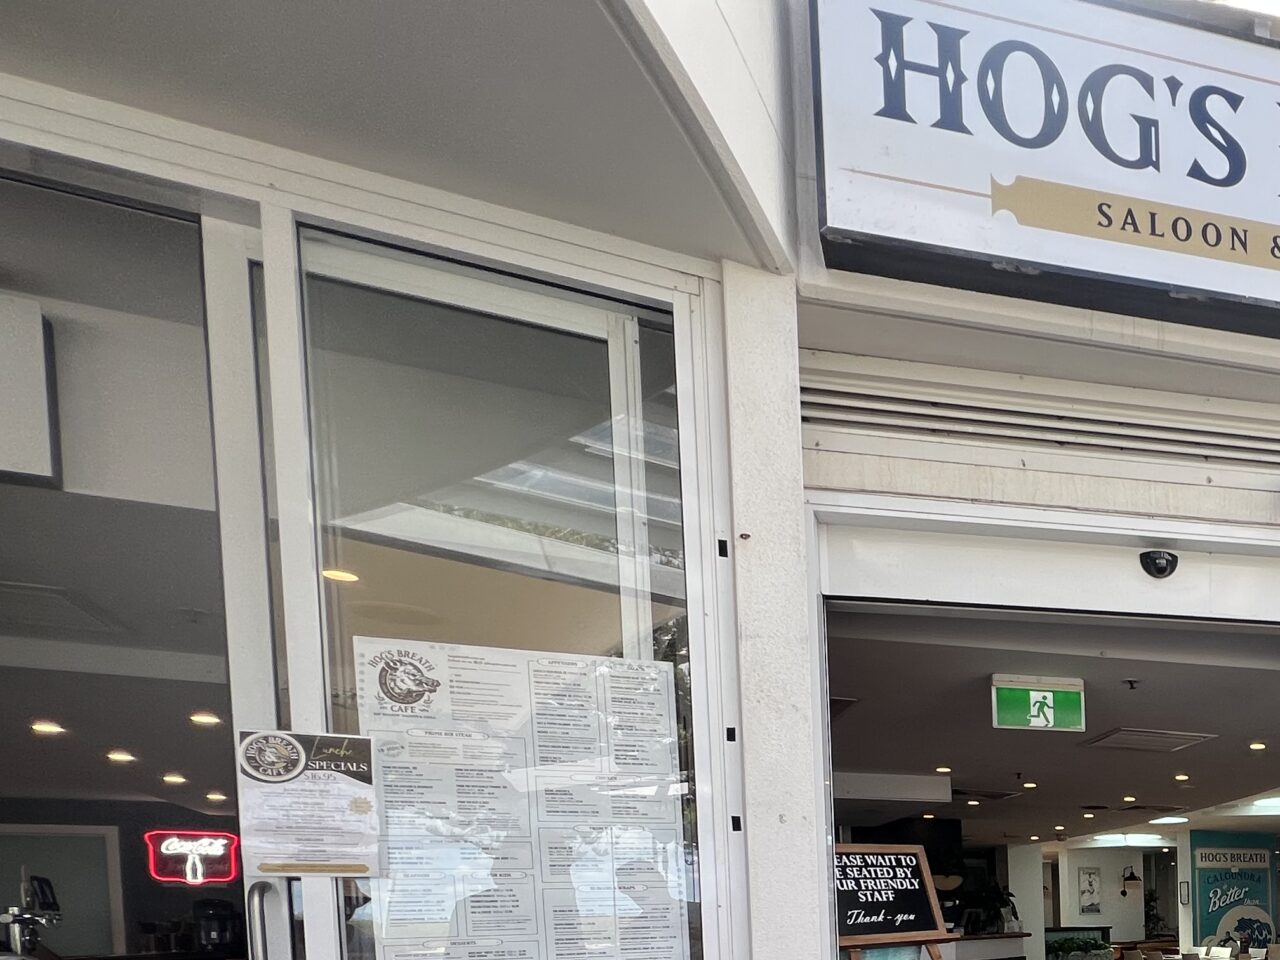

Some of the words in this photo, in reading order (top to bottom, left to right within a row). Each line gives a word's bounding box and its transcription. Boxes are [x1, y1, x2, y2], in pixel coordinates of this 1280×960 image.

[868, 8, 1247, 188] HOG'S
[1097, 203, 1249, 255] SALOON
[396, 649, 436, 672] BREATH
[390, 705, 417, 714] CAFE
[310, 736, 353, 760] Lunch
[259, 766, 287, 776] CAFE
[307, 760, 368, 772] SPECIALS
[834, 854, 865, 866] EASE
[864, 854, 897, 866] WAIT
[898, 855, 917, 866] TO
[1200, 852, 1229, 863] HOG'S
[1230, 852, 1266, 863] BREATH
[835, 867, 844, 879] E
[846, 867, 894, 879] SEATED
[895, 867, 913, 878] BY
[1206, 871, 1263, 885] CALOUNDRA
[836, 879, 859, 891] UR
[859, 878, 920, 891] FRIENDLY
[857, 890, 896, 902] STAFF
[1208, 885, 1249, 913] Better
